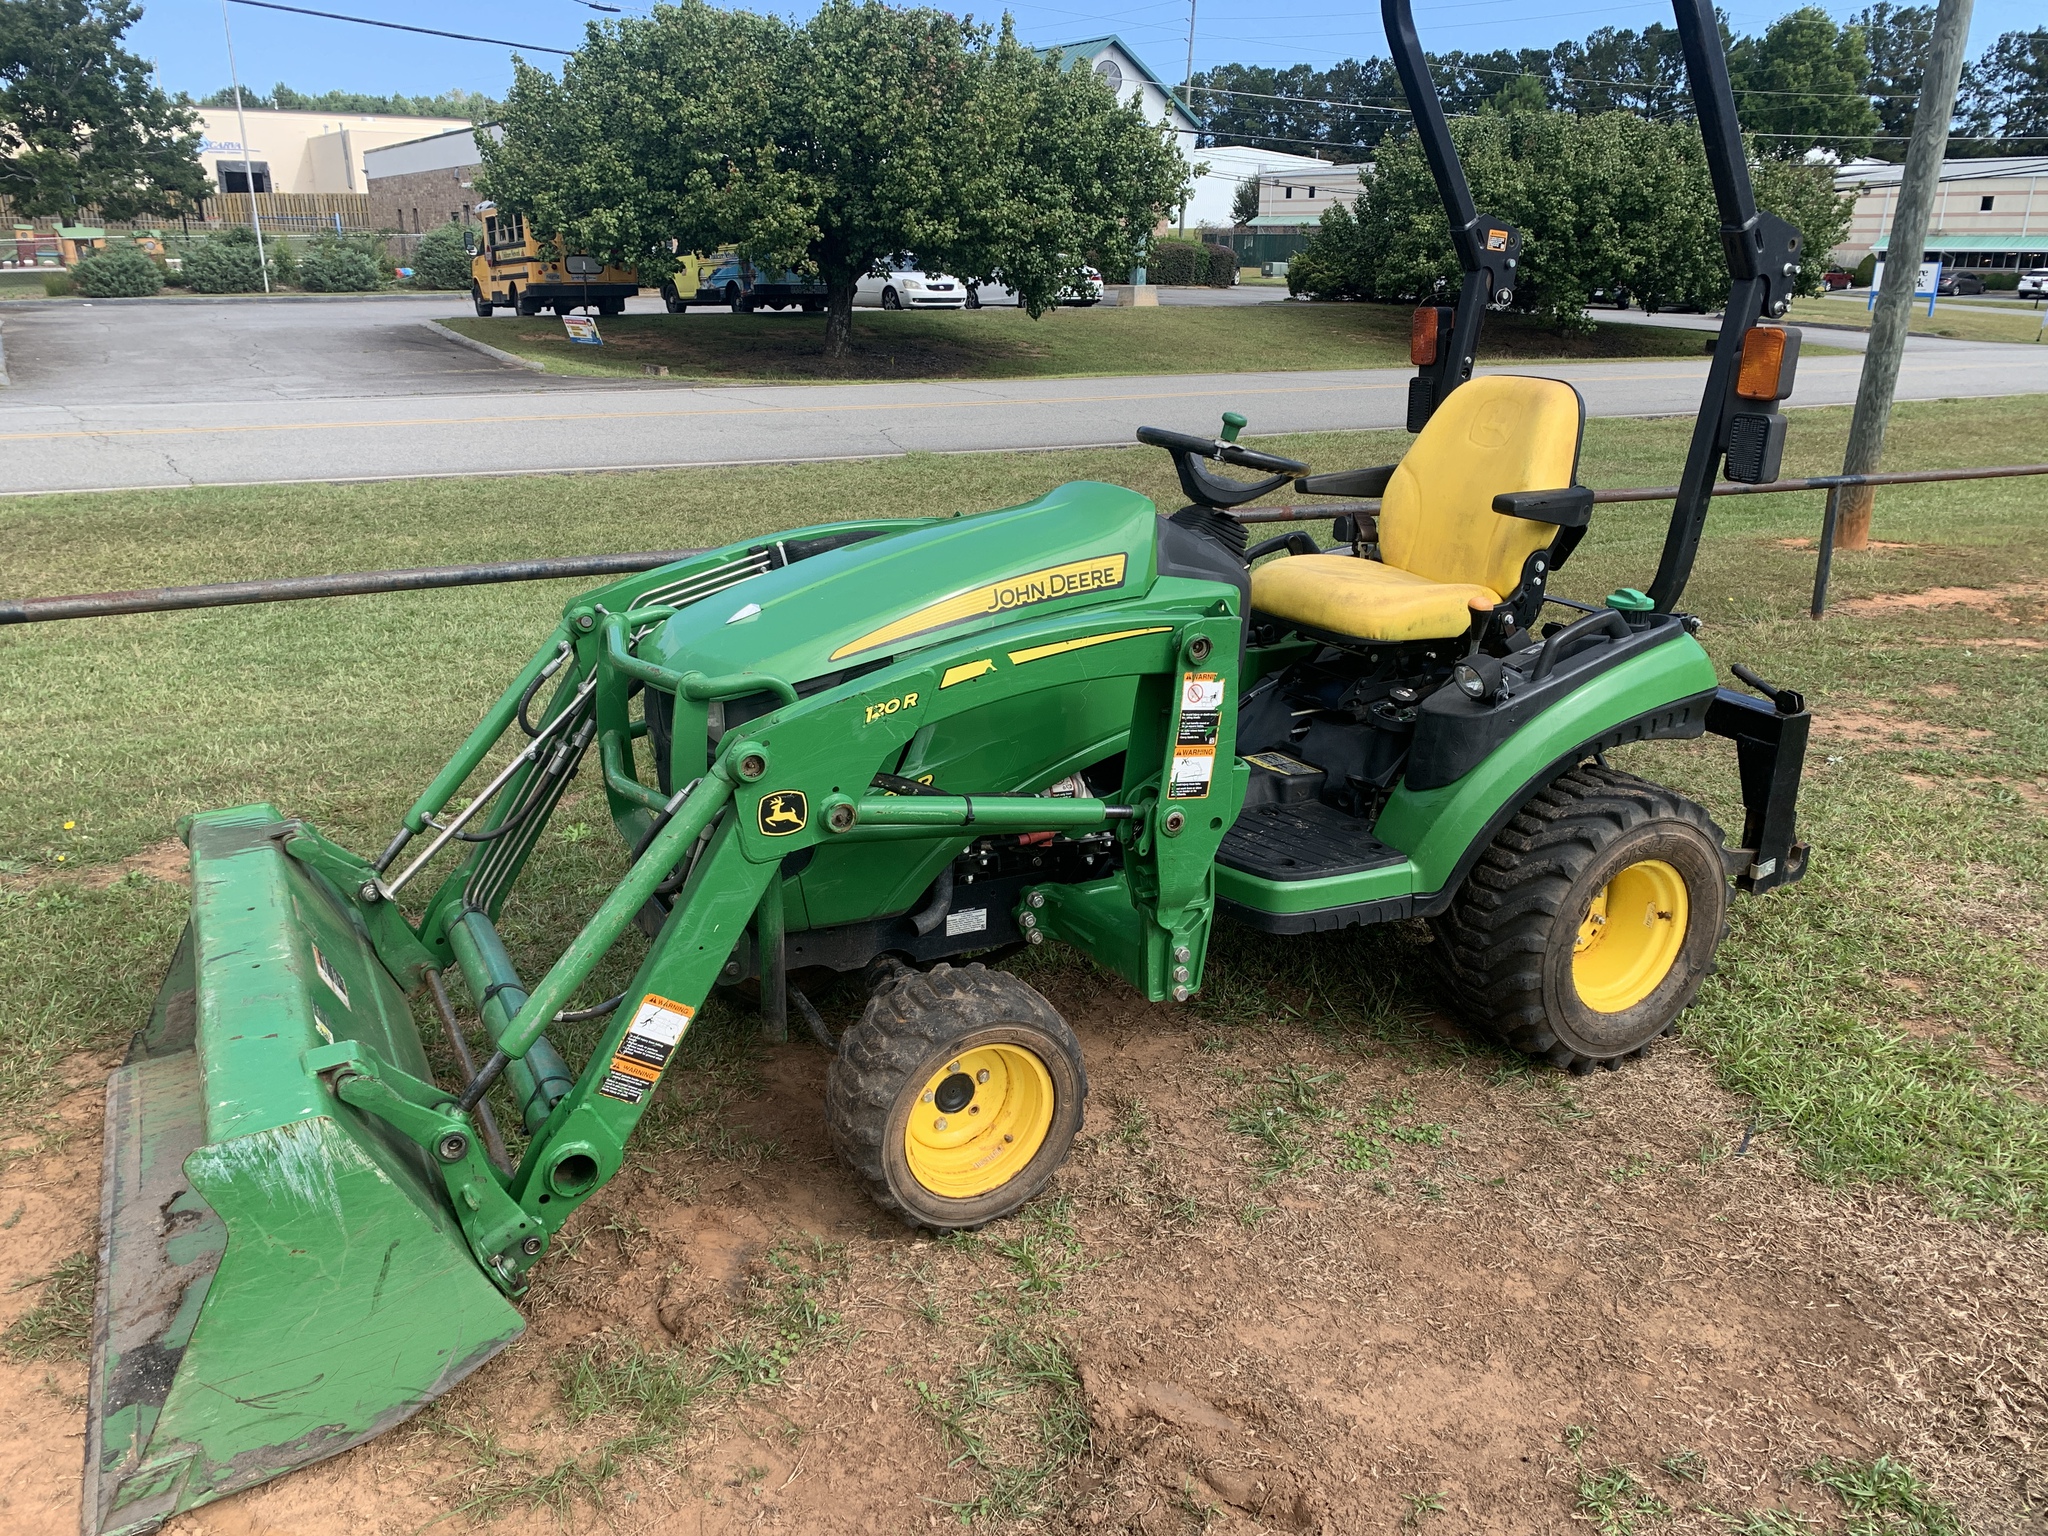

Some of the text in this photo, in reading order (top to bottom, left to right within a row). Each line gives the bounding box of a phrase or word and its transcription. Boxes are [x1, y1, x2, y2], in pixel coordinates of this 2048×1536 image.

[987, 567, 1116, 610] JOHN DEERE
[658, 1000, 690, 1015] WARNING
[623, 1064, 655, 1080] WARNING
